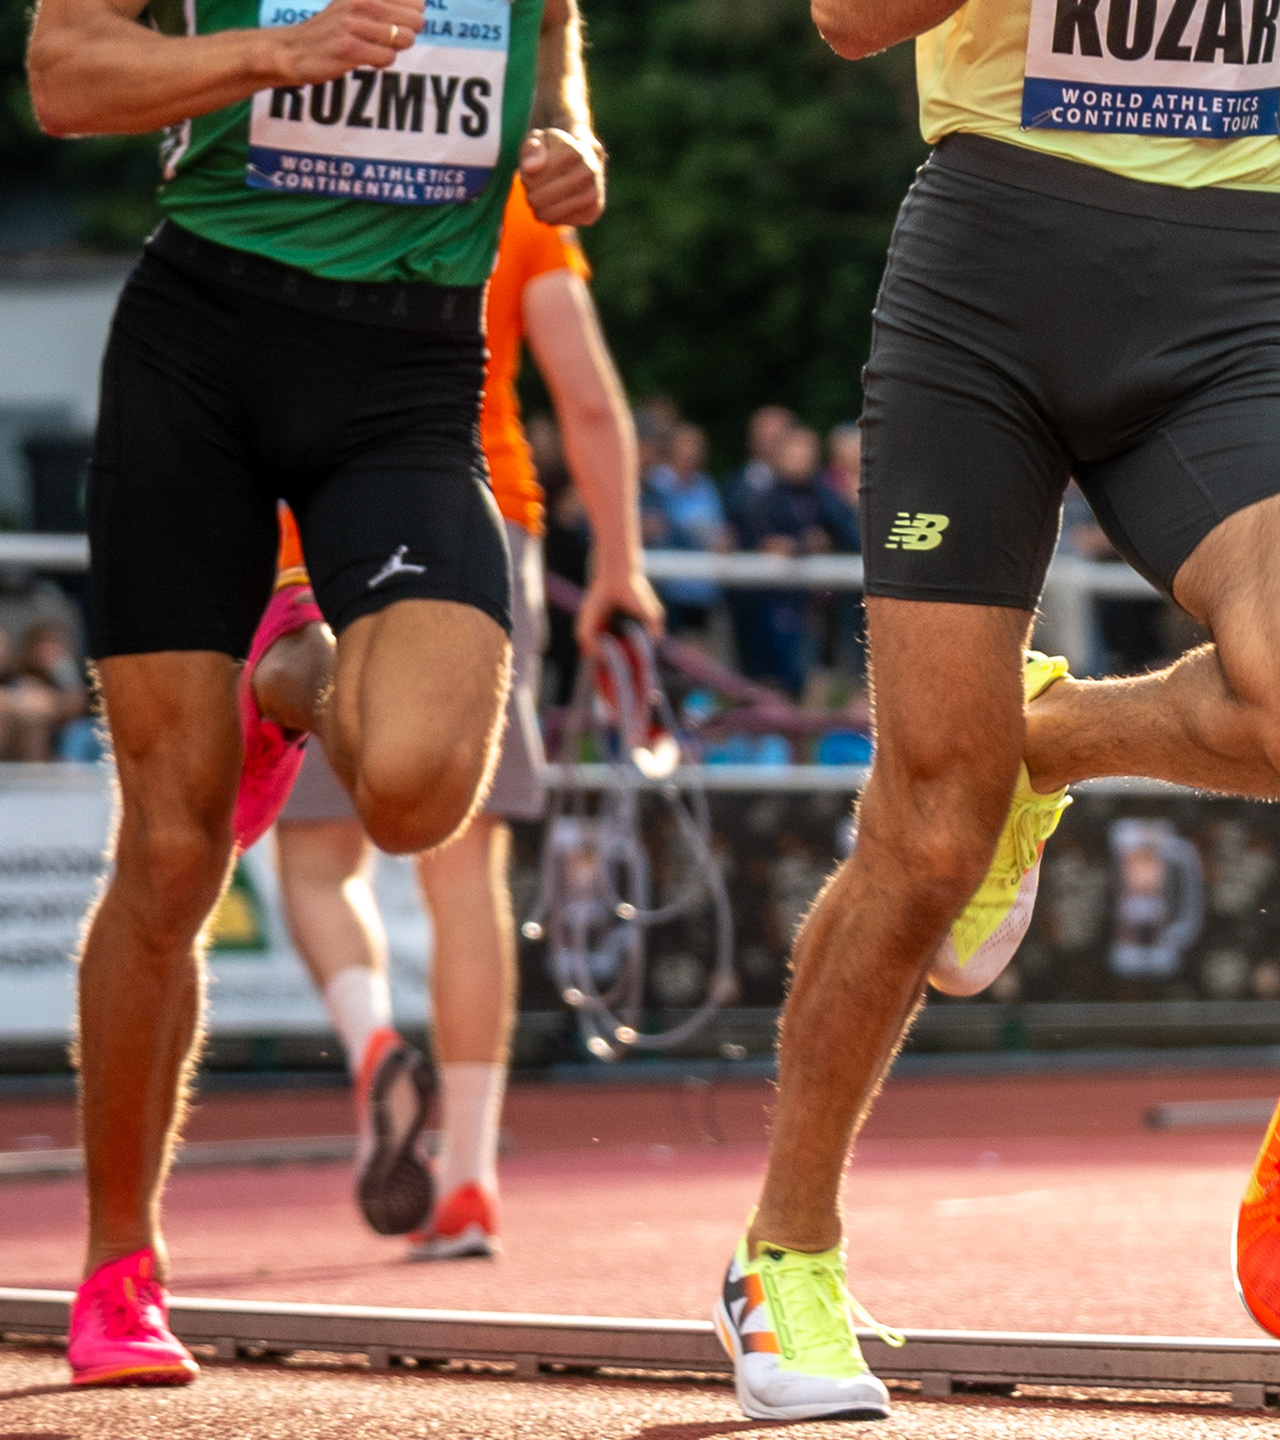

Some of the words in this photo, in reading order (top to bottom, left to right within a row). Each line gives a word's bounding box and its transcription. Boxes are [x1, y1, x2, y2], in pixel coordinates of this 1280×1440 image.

[458, 22, 502, 41] 2025
[1061, 87, 1143, 109] WORLD
[1152, 94, 1259, 114] ATHLETICS
[1052, 106, 1212, 132] CONTINENTAL
[1222, 113, 1259, 132] TOUR
[280, 154, 355, 176] WORLD
[363, 164, 466, 183] ATHLETICS
[272, 171, 417, 199] CONTINENTAL
[424, 185, 467, 200] TOUR
